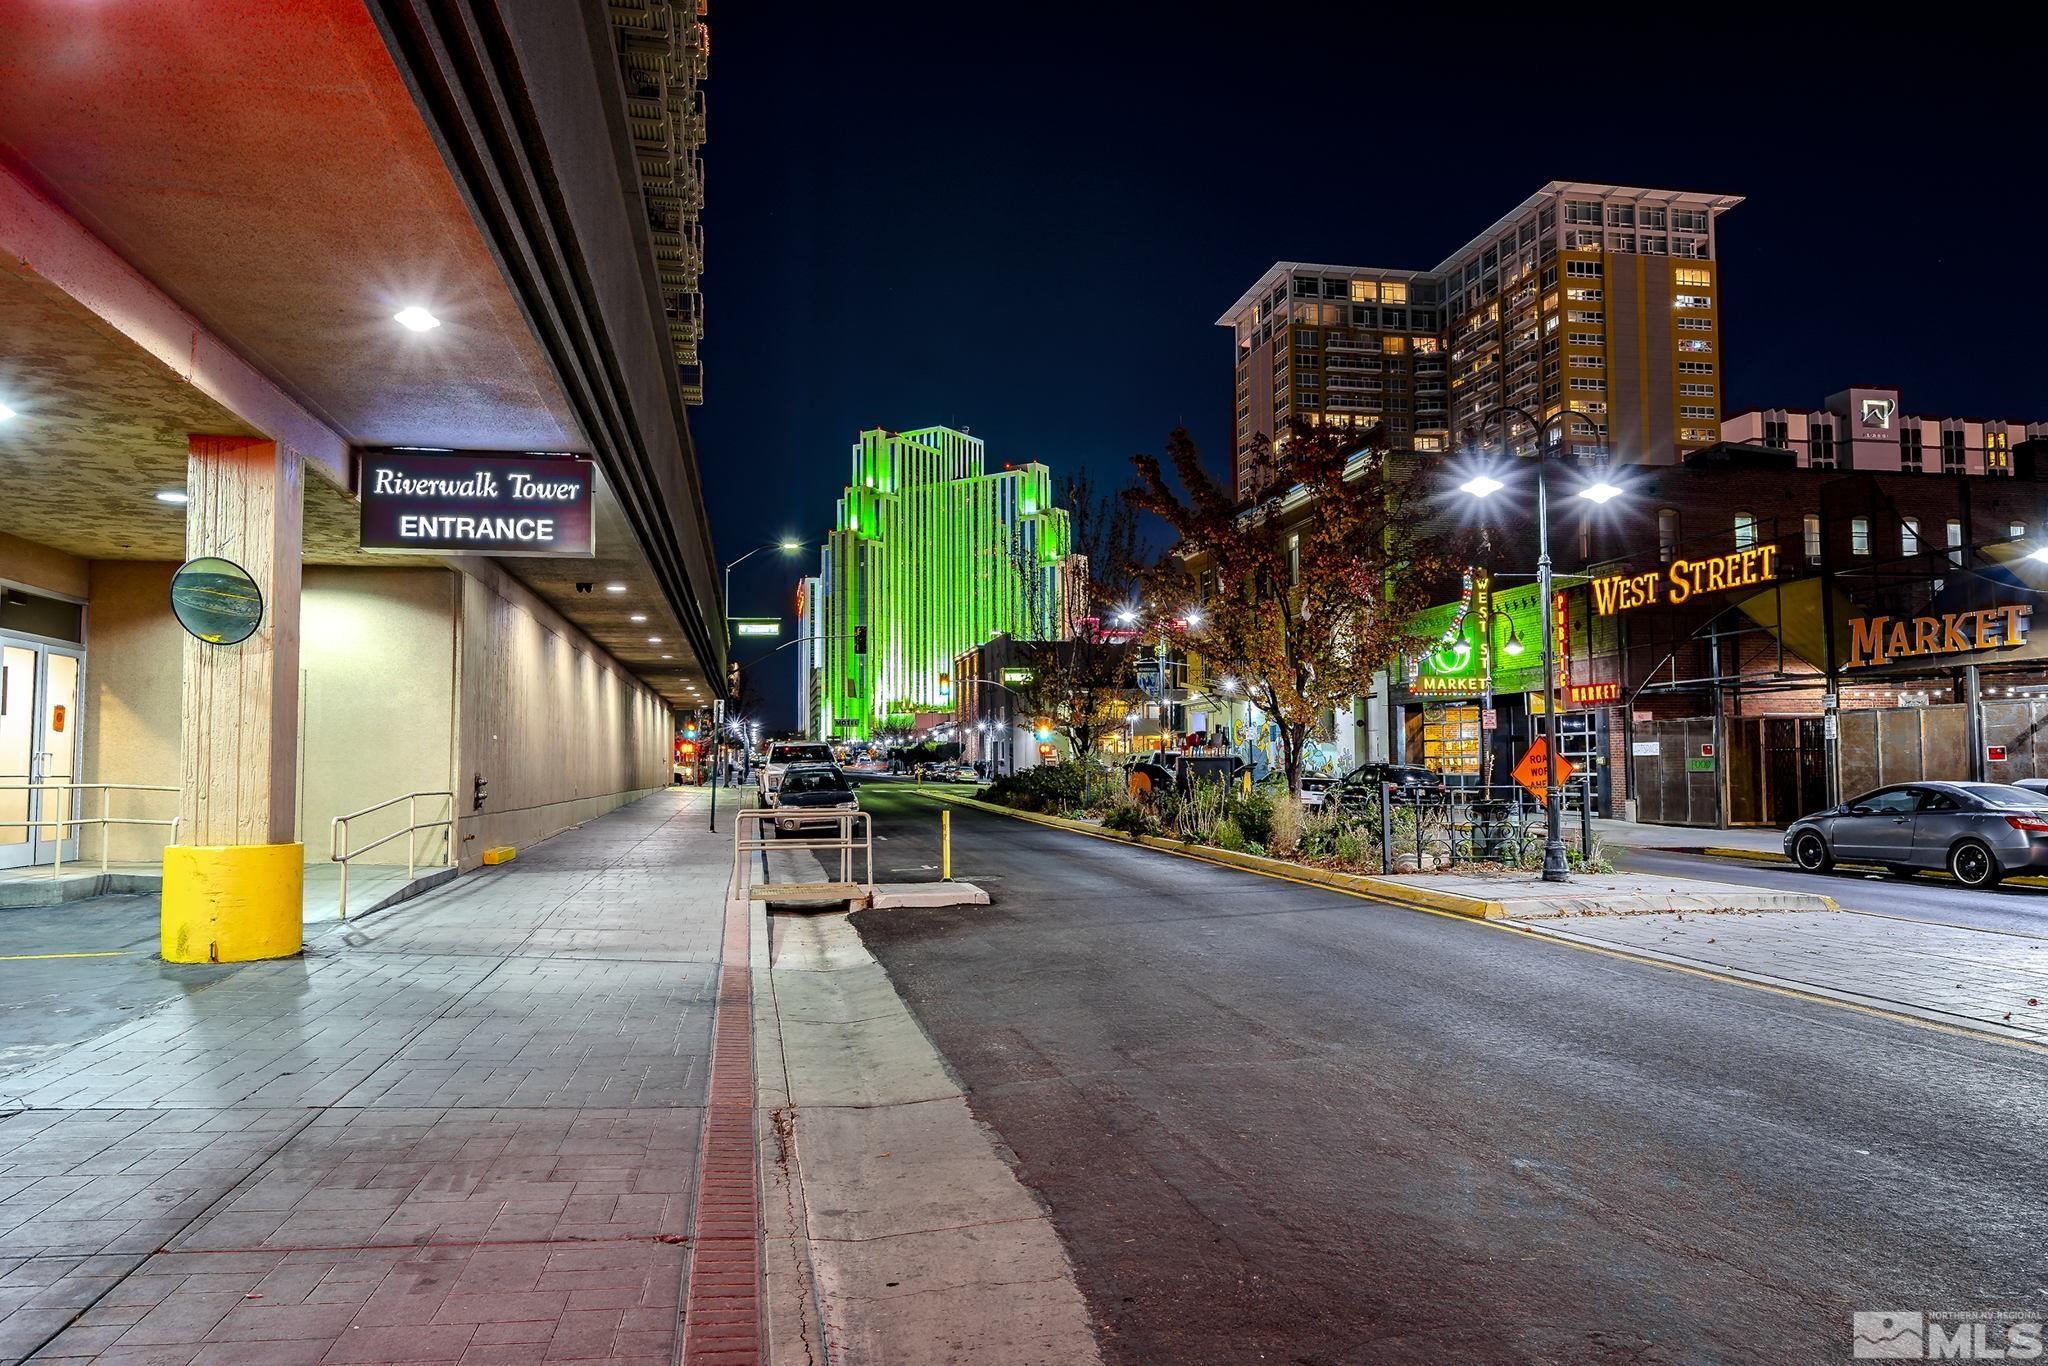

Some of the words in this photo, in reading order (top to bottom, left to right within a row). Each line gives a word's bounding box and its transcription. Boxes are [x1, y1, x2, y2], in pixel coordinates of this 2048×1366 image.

[373, 469, 498, 497] Riverwalk
[508, 473, 580, 500] Tower
[400, 516, 554, 540] ENTRANCE
[1593, 572, 1659, 616] WEST
[1670, 545, 1776, 604] STREET
[1476, 578, 1488, 632] WEST
[1557, 595, 1566, 687] PUBLIC
[1847, 605, 2032, 668] MARKET
[1481, 643, 1488, 669] ST
[1424, 678, 1486, 690] MARKET
[1571, 685, 1616, 702] MARKET
[1530, 755, 1547, 764] ROA
[1691, 760, 1711, 770] FOOD
[1529, 781, 1547, 789] AHE
